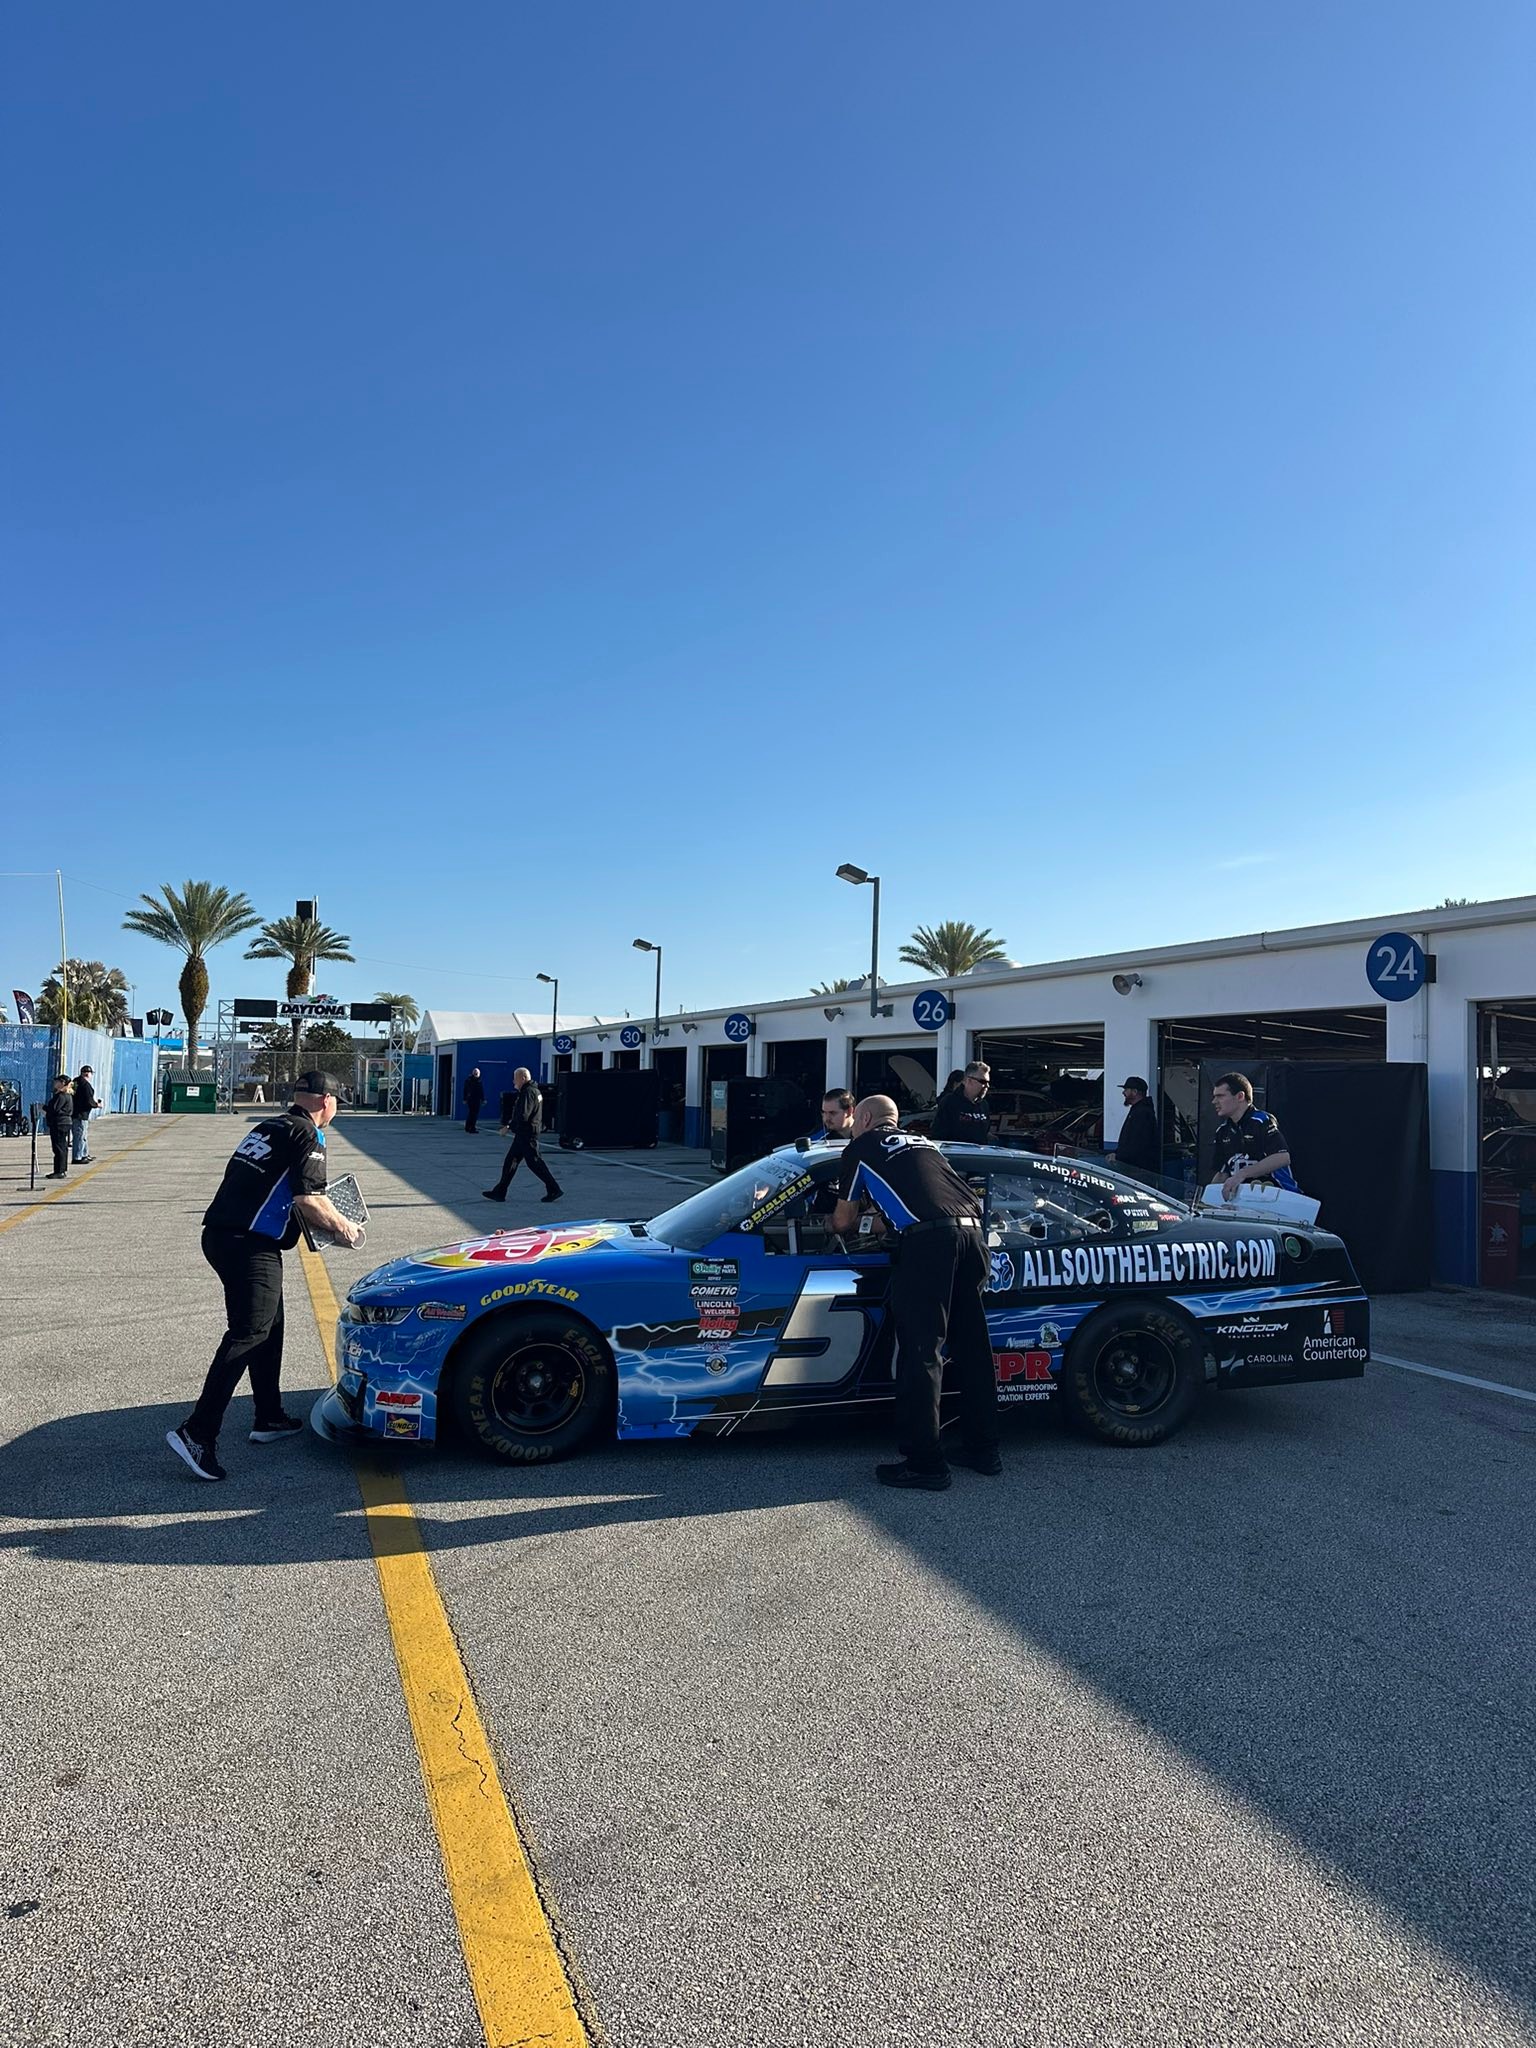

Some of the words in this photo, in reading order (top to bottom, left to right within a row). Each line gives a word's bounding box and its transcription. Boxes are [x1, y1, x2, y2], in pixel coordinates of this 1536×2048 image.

[1376, 946, 1418, 981] 24
[281, 1004, 345, 1015] DAYTONA
[918, 1001, 945, 1021] 26
[728, 1020, 749, 1036] 28
[623, 1031, 640, 1044] 30
[556, 1039, 571, 1050] 32
[797, 1174, 812, 1189] IN
[1033, 1161, 1070, 1177] RAPID
[1080, 1173, 1116, 1191] FIRED
[1063, 1176, 1088, 1189] PIZZA
[755, 1209, 775, 1225] FOCUS
[1022, 1238, 1277, 1288] ALLSOUTHELECTRIC.COM
[480, 1279, 580, 1306] GOODYEAR
[691, 1285, 737, 1295] COMETIC
[699, 1317, 738, 1331] Holley
[1144, 1312, 1193, 1349] EAGLE
[1216, 1323, 1289, 1334] KINGDOM
[697, 1329, 732, 1339] MSD
[1303, 1336, 1356, 1348] American
[563, 1328, 609, 1376] EAGLE
[1247, 1354, 1294, 1363] CAROLINA
[1303, 1348, 1367, 1361] Countertop
[996, 1383, 1058, 1393] G/WATERPROOFING
[997, 1393, 1024, 1402] ORATION
[1025, 1392, 1050, 1401] EXPERTS
[387, 1422, 418, 1431] SUNOCO
